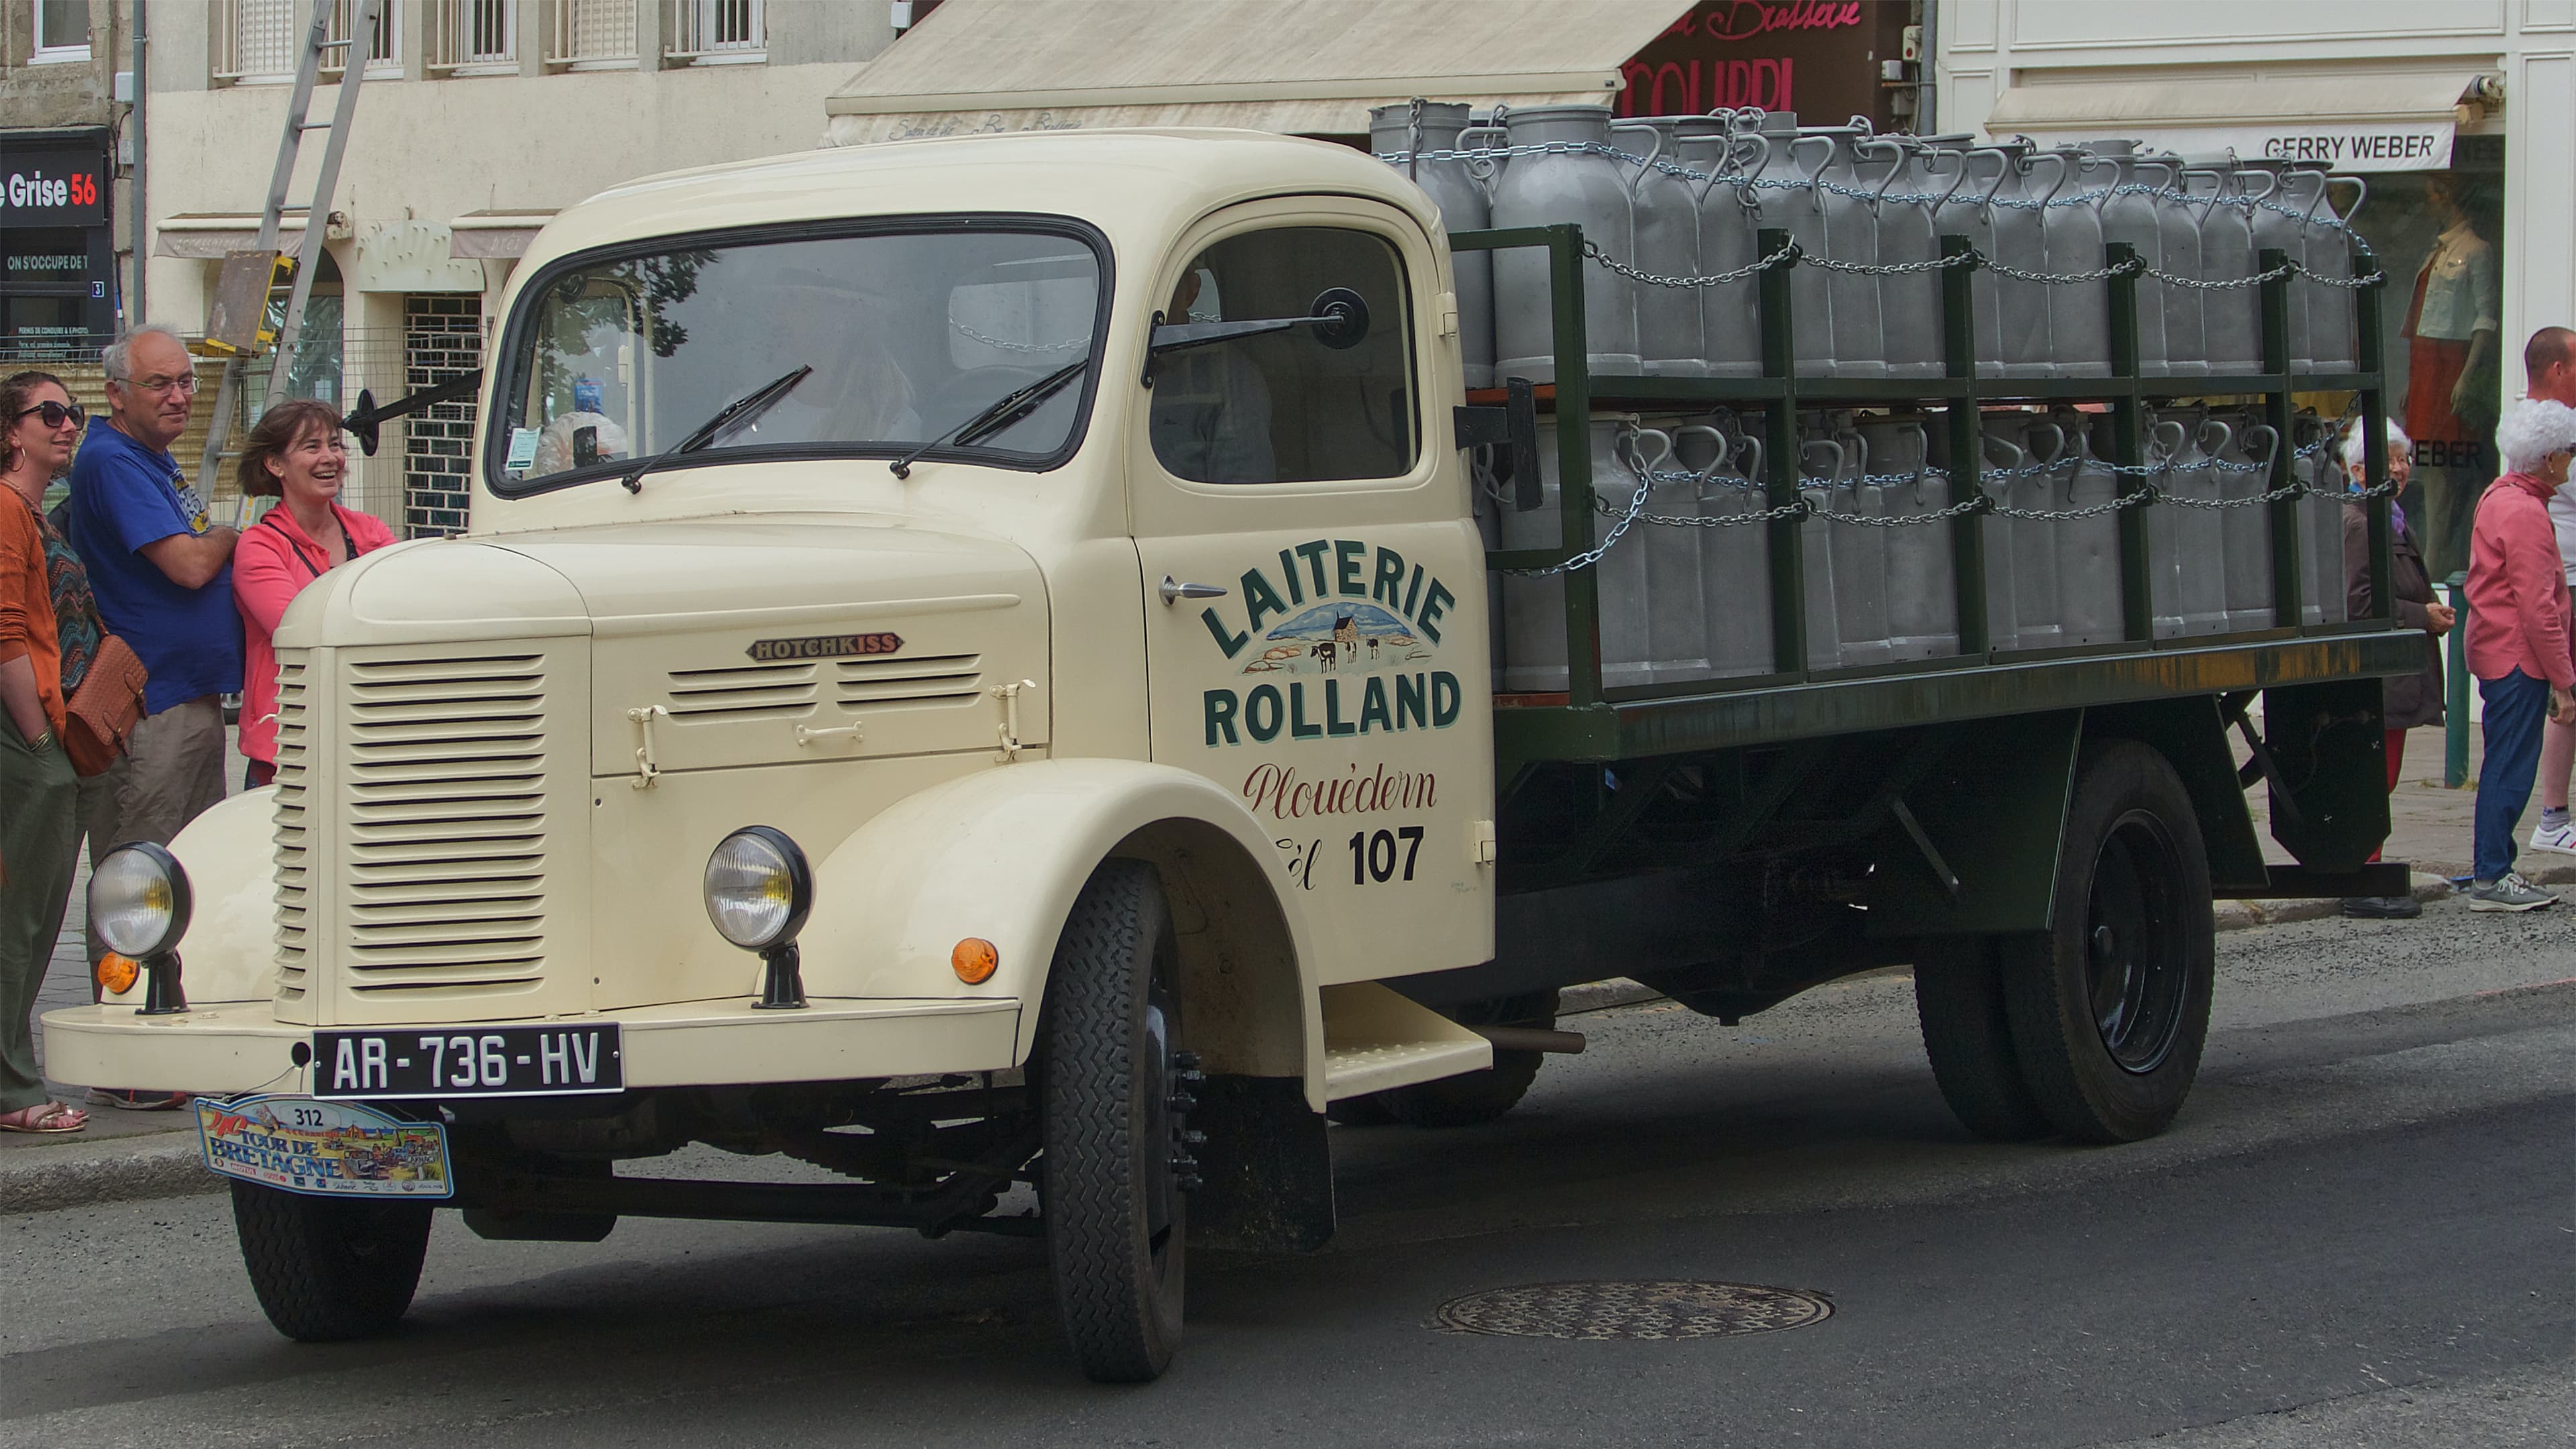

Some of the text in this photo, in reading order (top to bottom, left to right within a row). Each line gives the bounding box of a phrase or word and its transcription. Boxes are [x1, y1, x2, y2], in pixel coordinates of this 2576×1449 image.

[2265, 136, 2345, 160] GERRY
[2351, 135, 2434, 159] WEBER
[9, 170, 67, 207] Grise
[71, 173, 96, 205] 56
[7, 256, 21, 270] ON
[23, 255, 68, 270] S'OCCUPE
[70, 255, 82, 269] DE
[2416, 440, 2481, 468] EBER
[1200, 539, 1455, 660] LAITERIE
[756, 634, 895, 659] HOTCHKISS
[1203, 672, 1461, 747] ROLLAND
[1243, 763, 1437, 819] Plouédern
[1350, 826, 1424, 885] 107
[295, 1108, 323, 1126] 312
[209, 1136, 344, 1179] BRETAGNE
[239, 1129, 289, 1153] TOUR
[292, 1140, 320, 1156] DE
